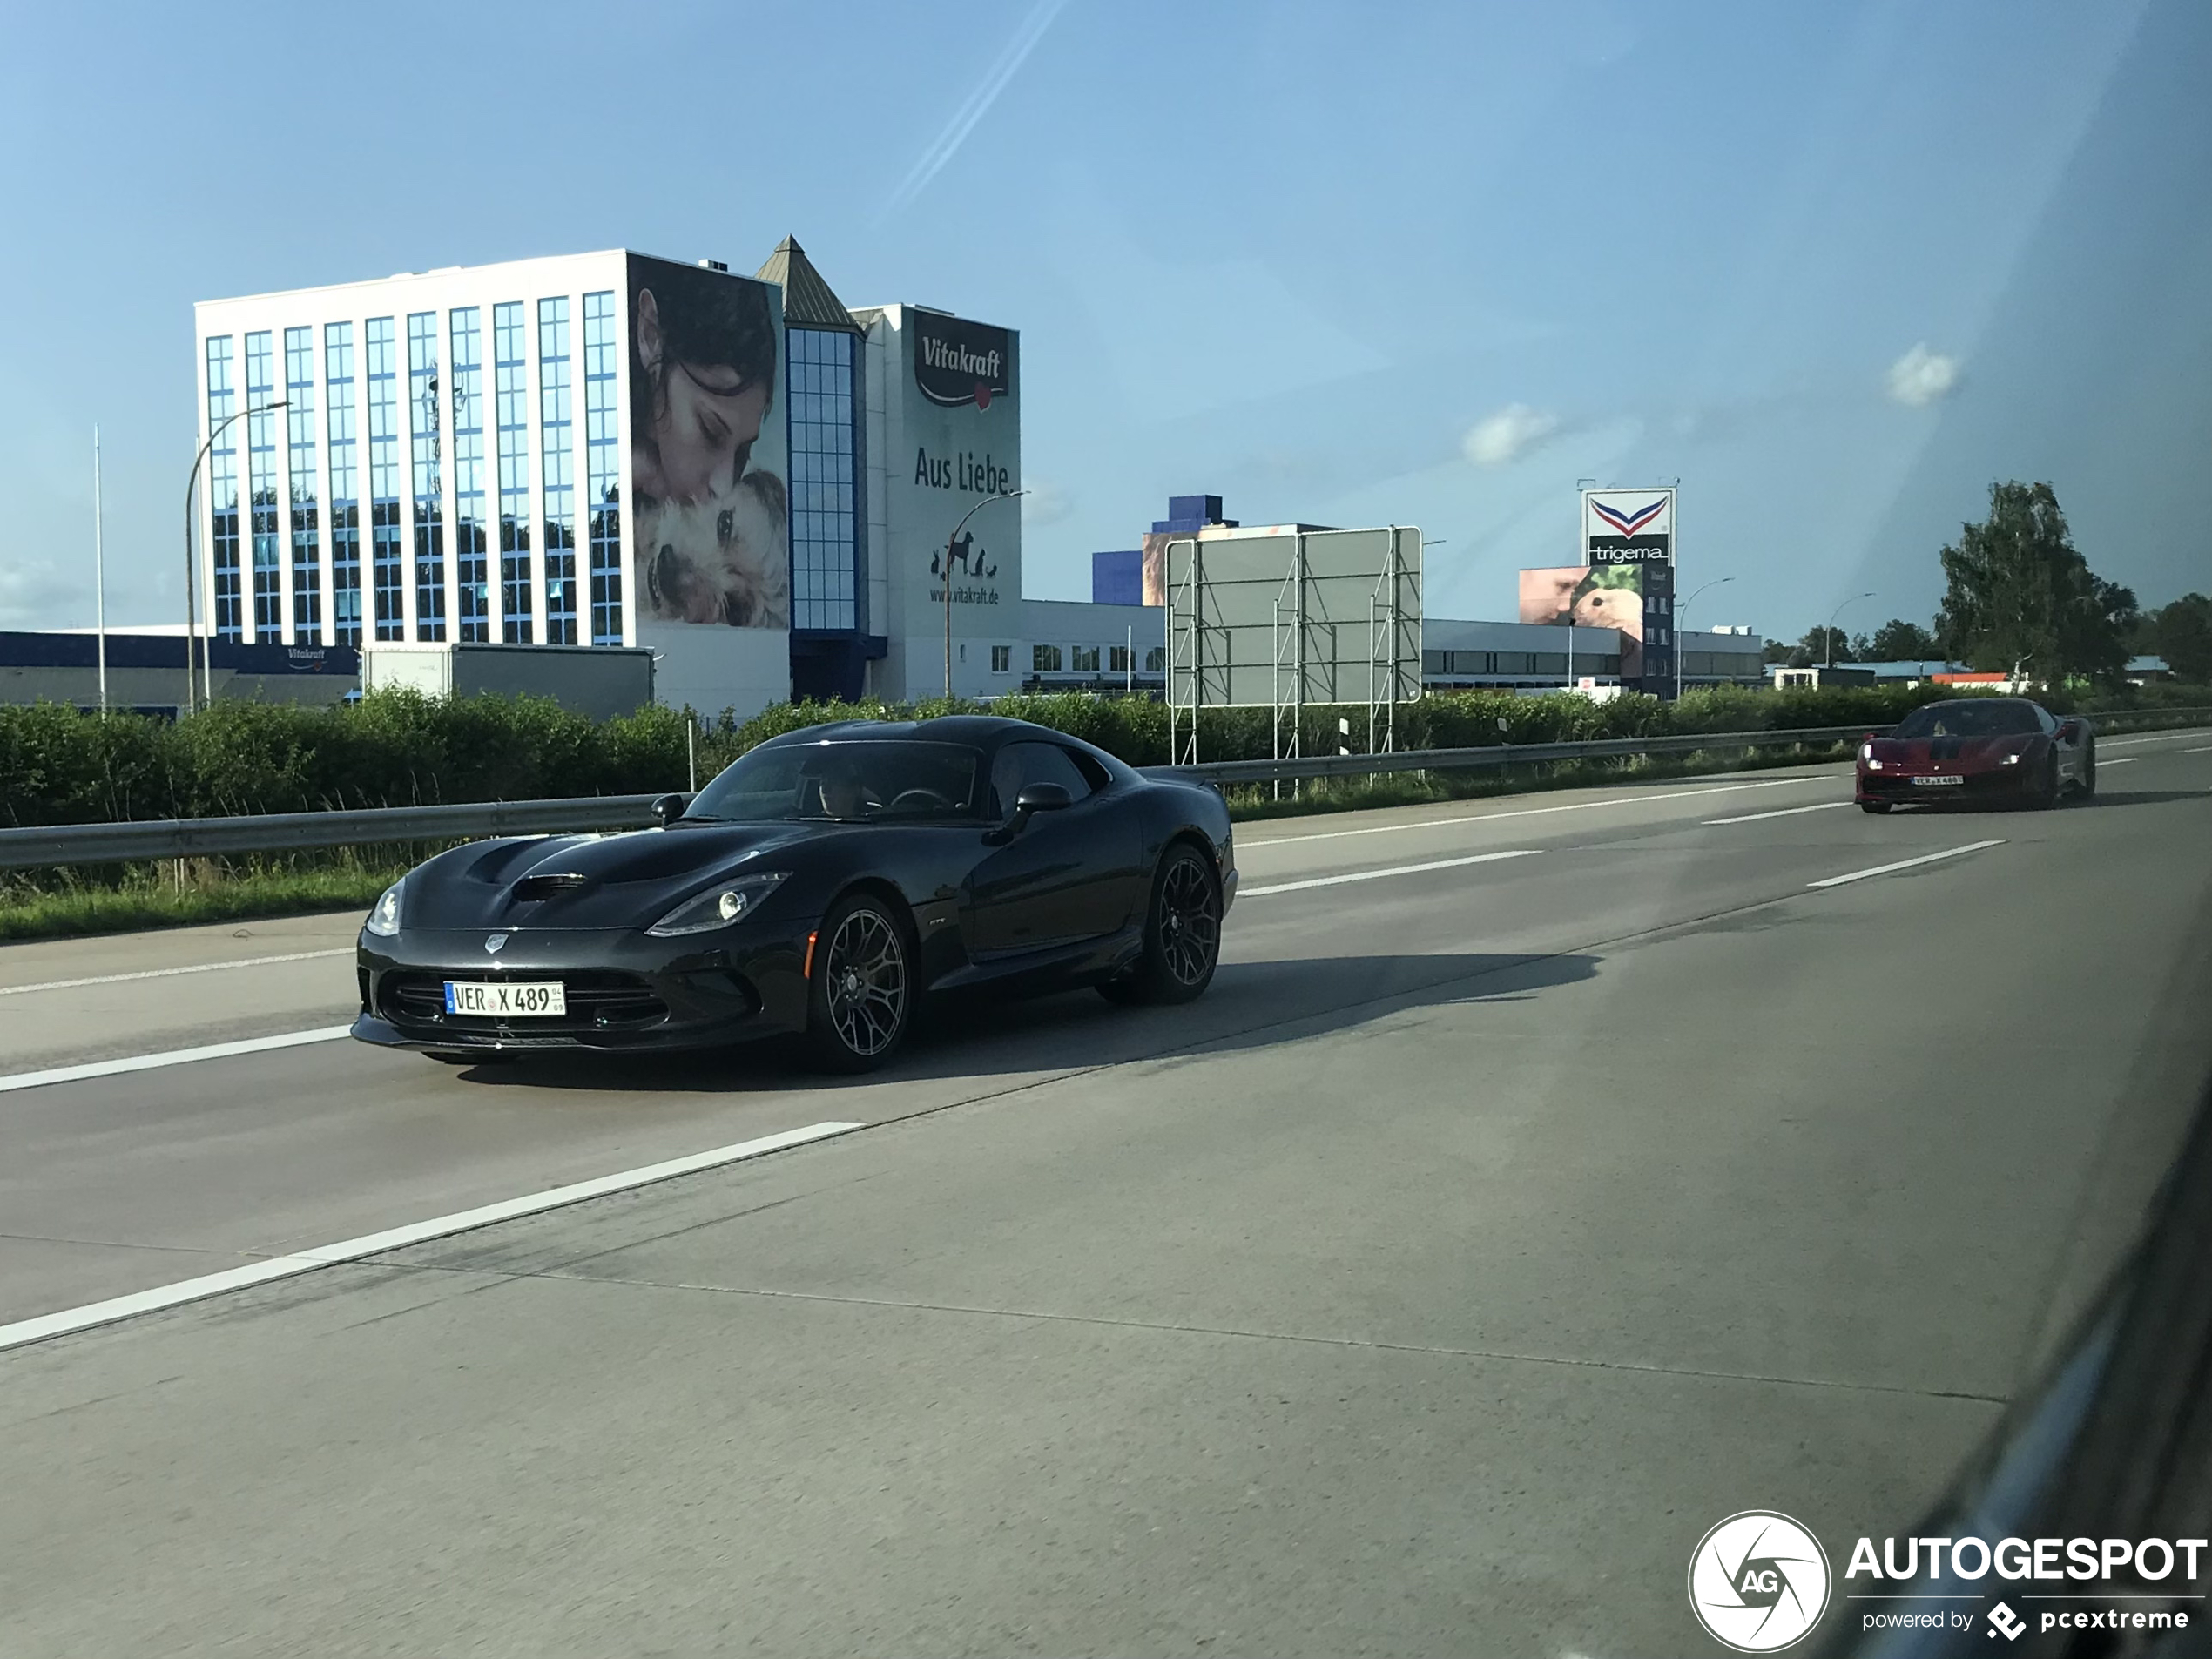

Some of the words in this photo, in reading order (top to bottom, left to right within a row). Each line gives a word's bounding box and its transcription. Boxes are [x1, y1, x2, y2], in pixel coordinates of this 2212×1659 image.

[922, 336, 1001, 379] Vitakraft
[915, 447, 951, 489] Aus
[959, 451, 1014, 496] Liebe.
[1595, 545, 1663, 563] trigema
[288, 648, 325, 659] Vitakraft
[455, 987, 486, 1011] VER
[498, 988, 509, 1011] X
[515, 988, 550, 1011] 489
